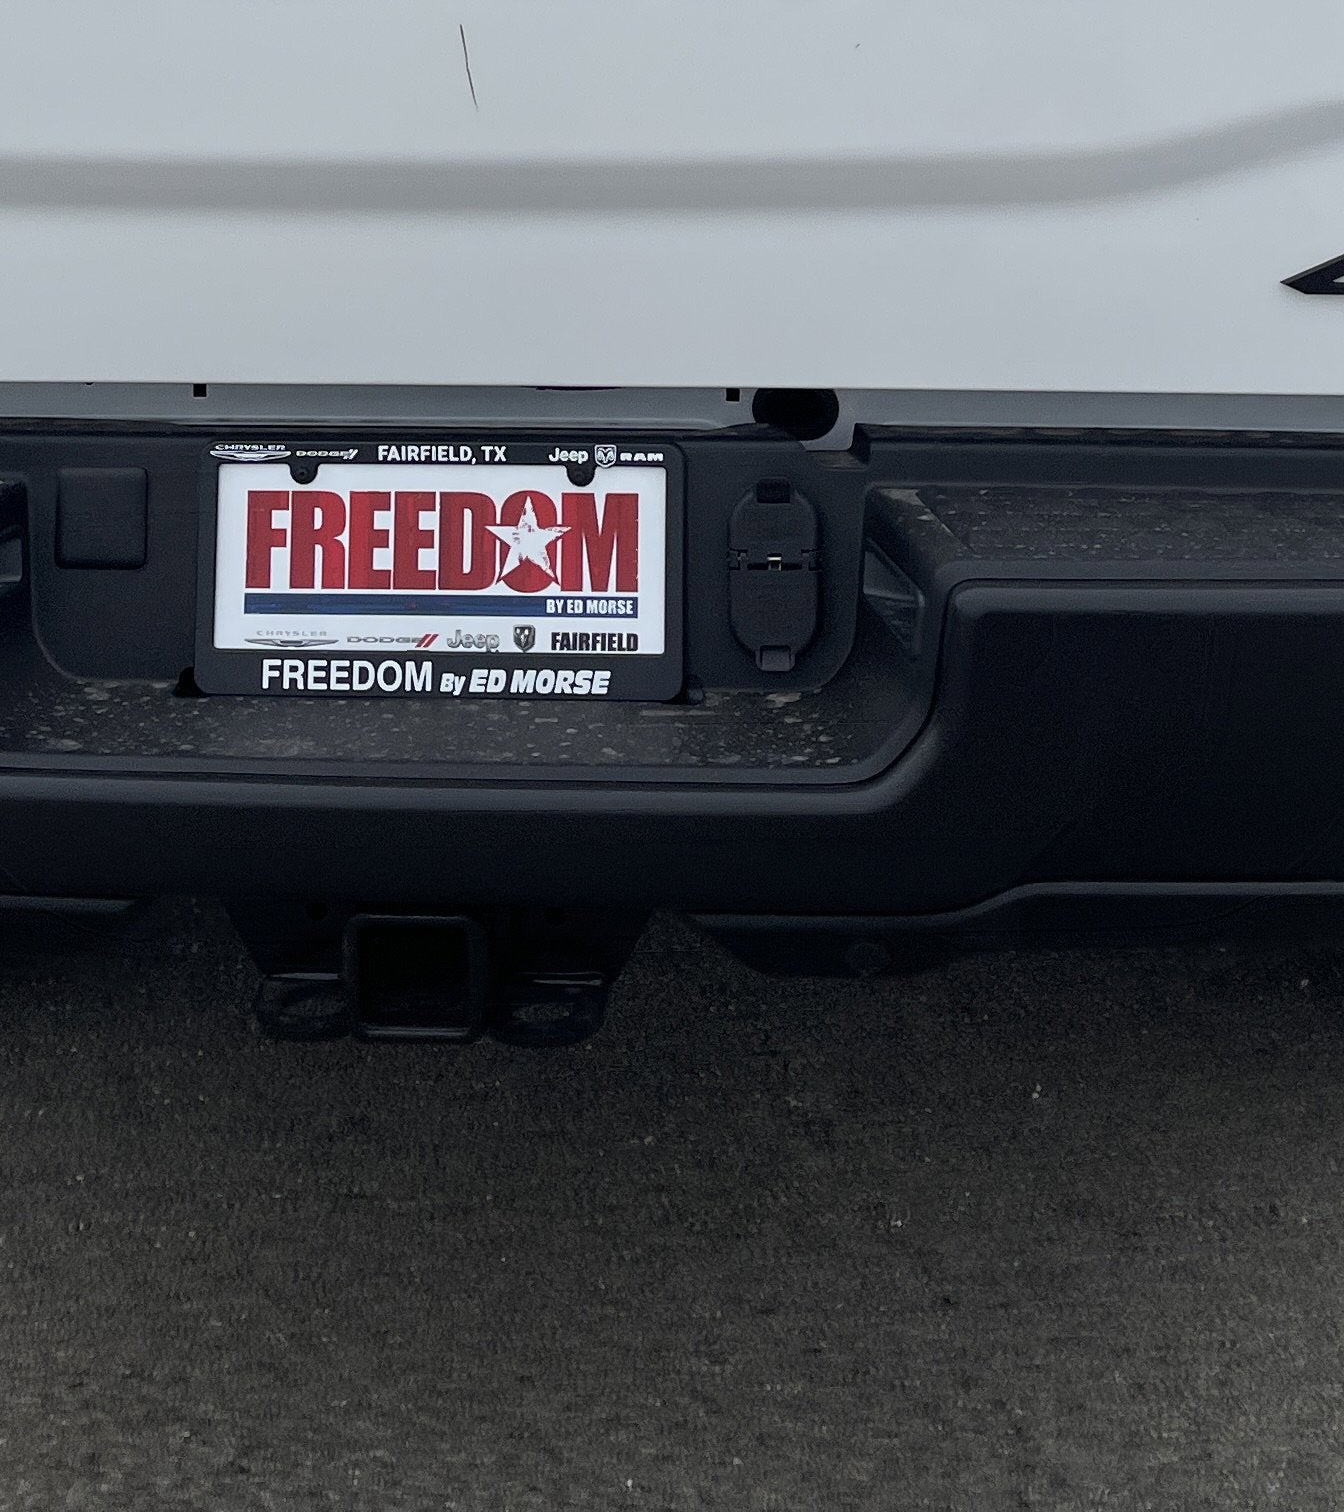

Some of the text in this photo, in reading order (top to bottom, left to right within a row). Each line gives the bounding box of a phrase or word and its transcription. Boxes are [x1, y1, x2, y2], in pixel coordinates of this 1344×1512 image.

[377, 445, 507, 465] FAIRFIELD, TX
[548, 447, 589, 464] Jeep
[619, 452, 664, 462] RAM
[245, 489, 639, 593] FREEDOM
[545, 599, 634, 615] BY ED MORSE
[447, 629, 500, 652] Jeep
[551, 632, 639, 652] FAIRFIELD
[262, 659, 612, 696] FREEDOM By ED MORSE
